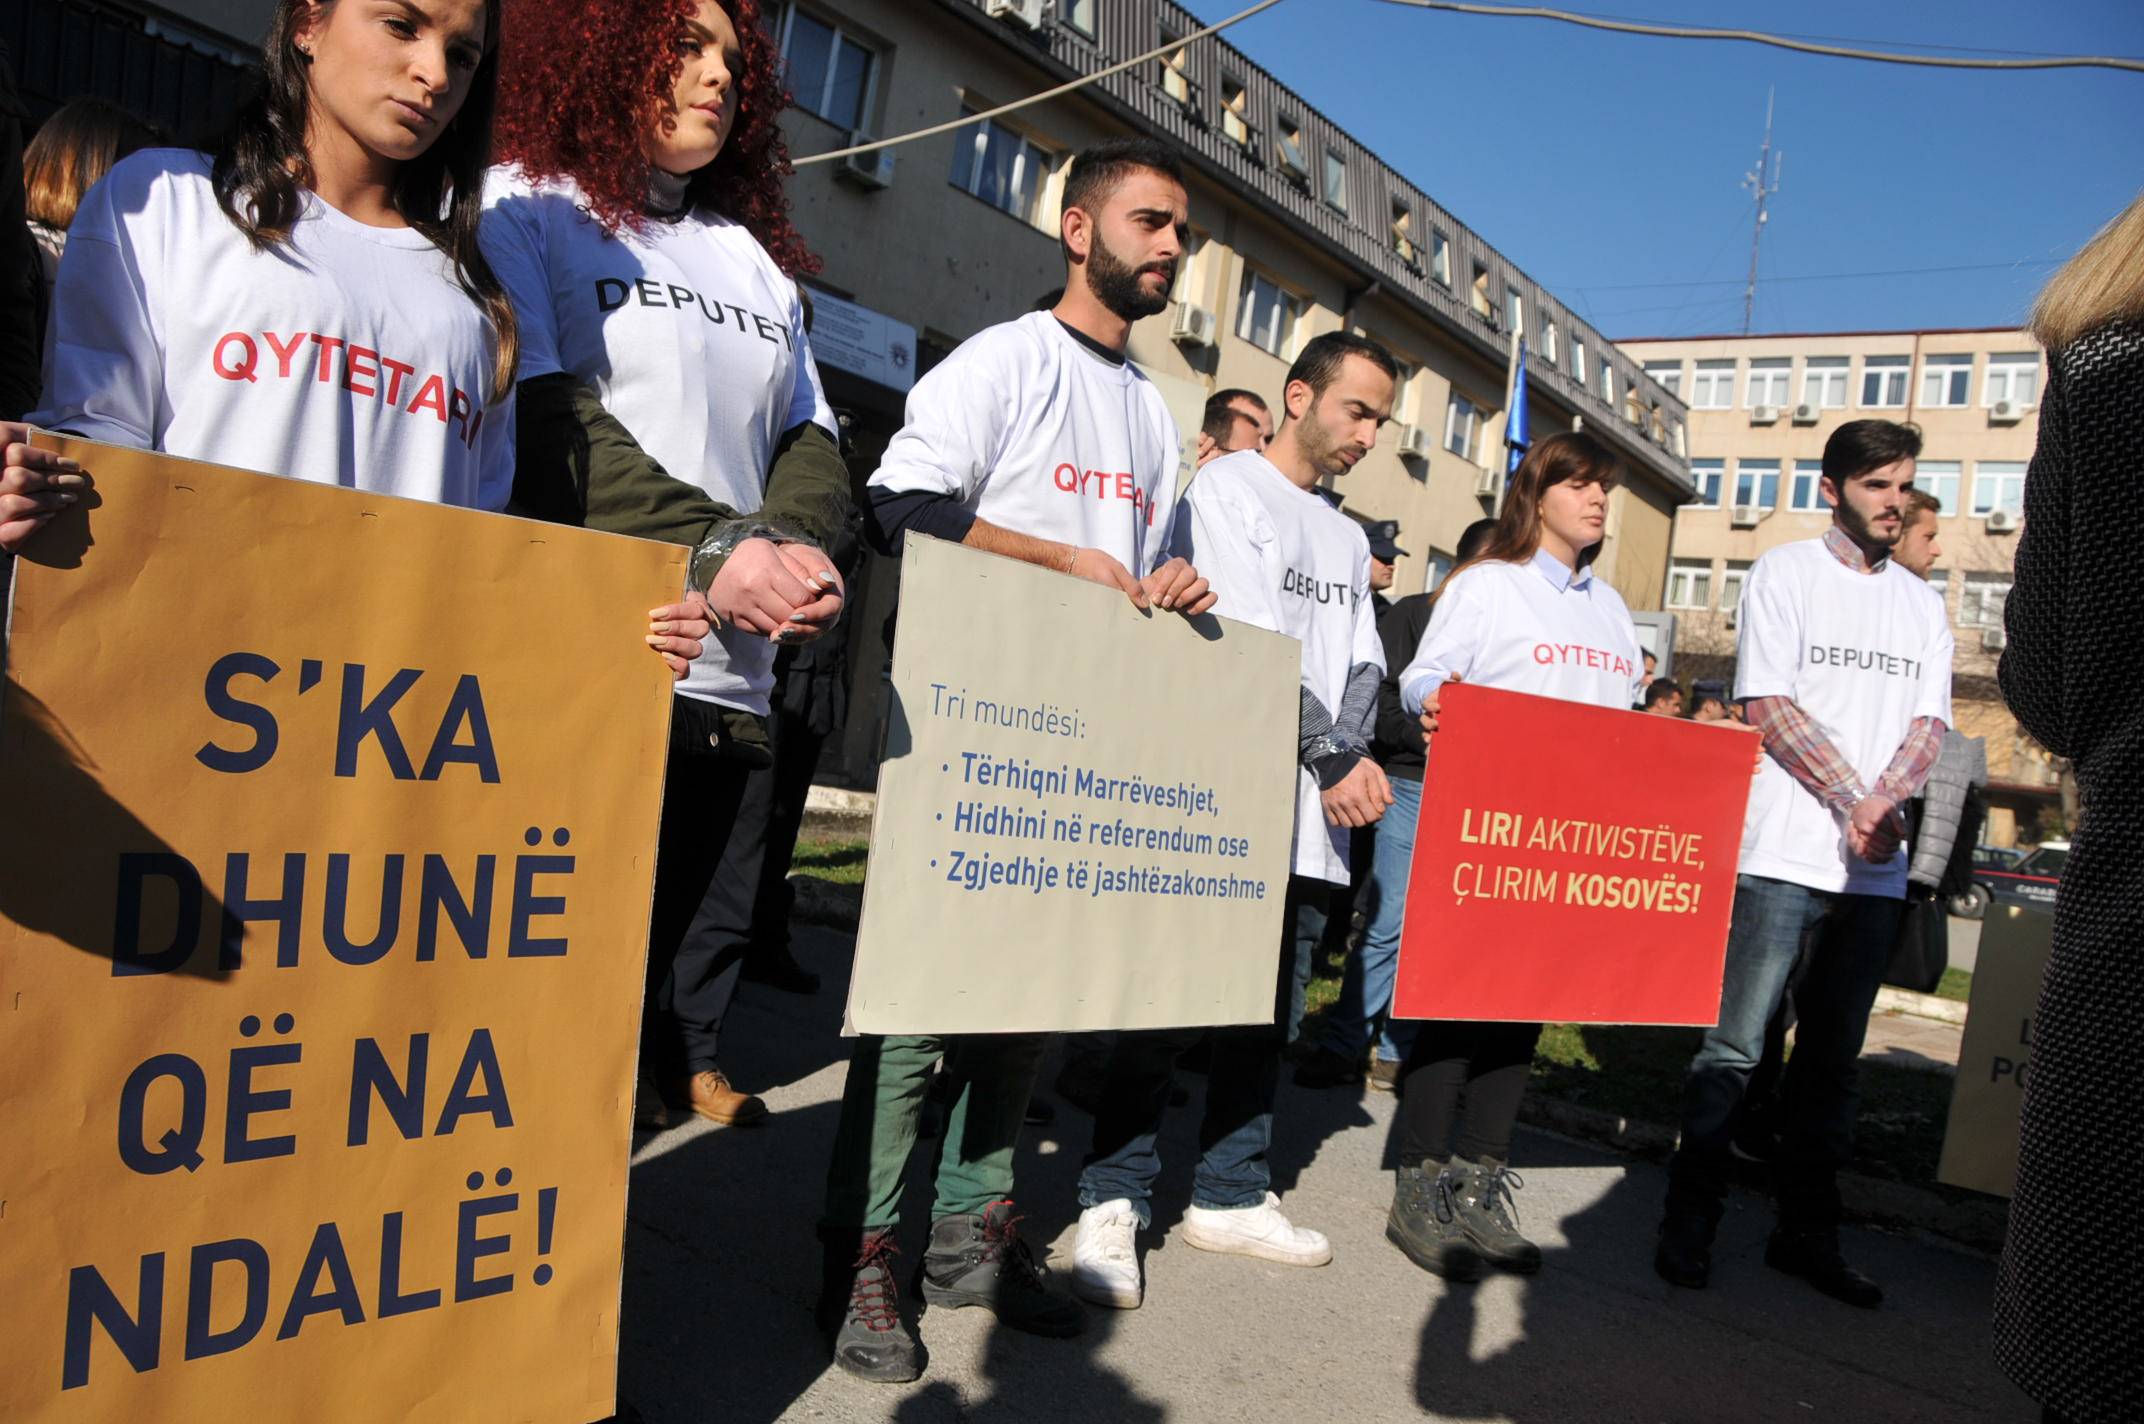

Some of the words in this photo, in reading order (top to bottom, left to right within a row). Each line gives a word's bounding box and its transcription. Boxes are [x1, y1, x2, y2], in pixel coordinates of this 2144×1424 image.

[212, 331, 484, 450] QYTETARI
[1810, 646, 1921, 680] DEPUTETI
[930, 683, 967, 719] Tri
[974, 703, 1086, 739] mundësi:
[961, 751, 1068, 799] Tërhiqni
[1074, 767, 1219, 818] Marrëveshjet,
[953, 801, 1047, 839] Hidhini
[1053, 813, 1082, 842] në
[1089, 818, 1213, 855] referendum
[1217, 836, 1249, 857] ose
[1460, 808, 1523, 848] LIRI
[1526, 817, 1705, 871] AKTIVISTËVE,
[111, 826, 576, 978] DHUNË
[946, 850, 1058, 894] Zgjedhje
[1066, 860, 1088, 889] të
[1092, 861, 1266, 900] jashtëzakonshme
[1452, 862, 1558, 906] ÇLIRIM
[1565, 872, 1702, 914] KOSOVËS!
[118, 1012, 302, 1175] QË
[347, 1028, 514, 1147] NA
[61, 1167, 558, 1391] NDALË!
